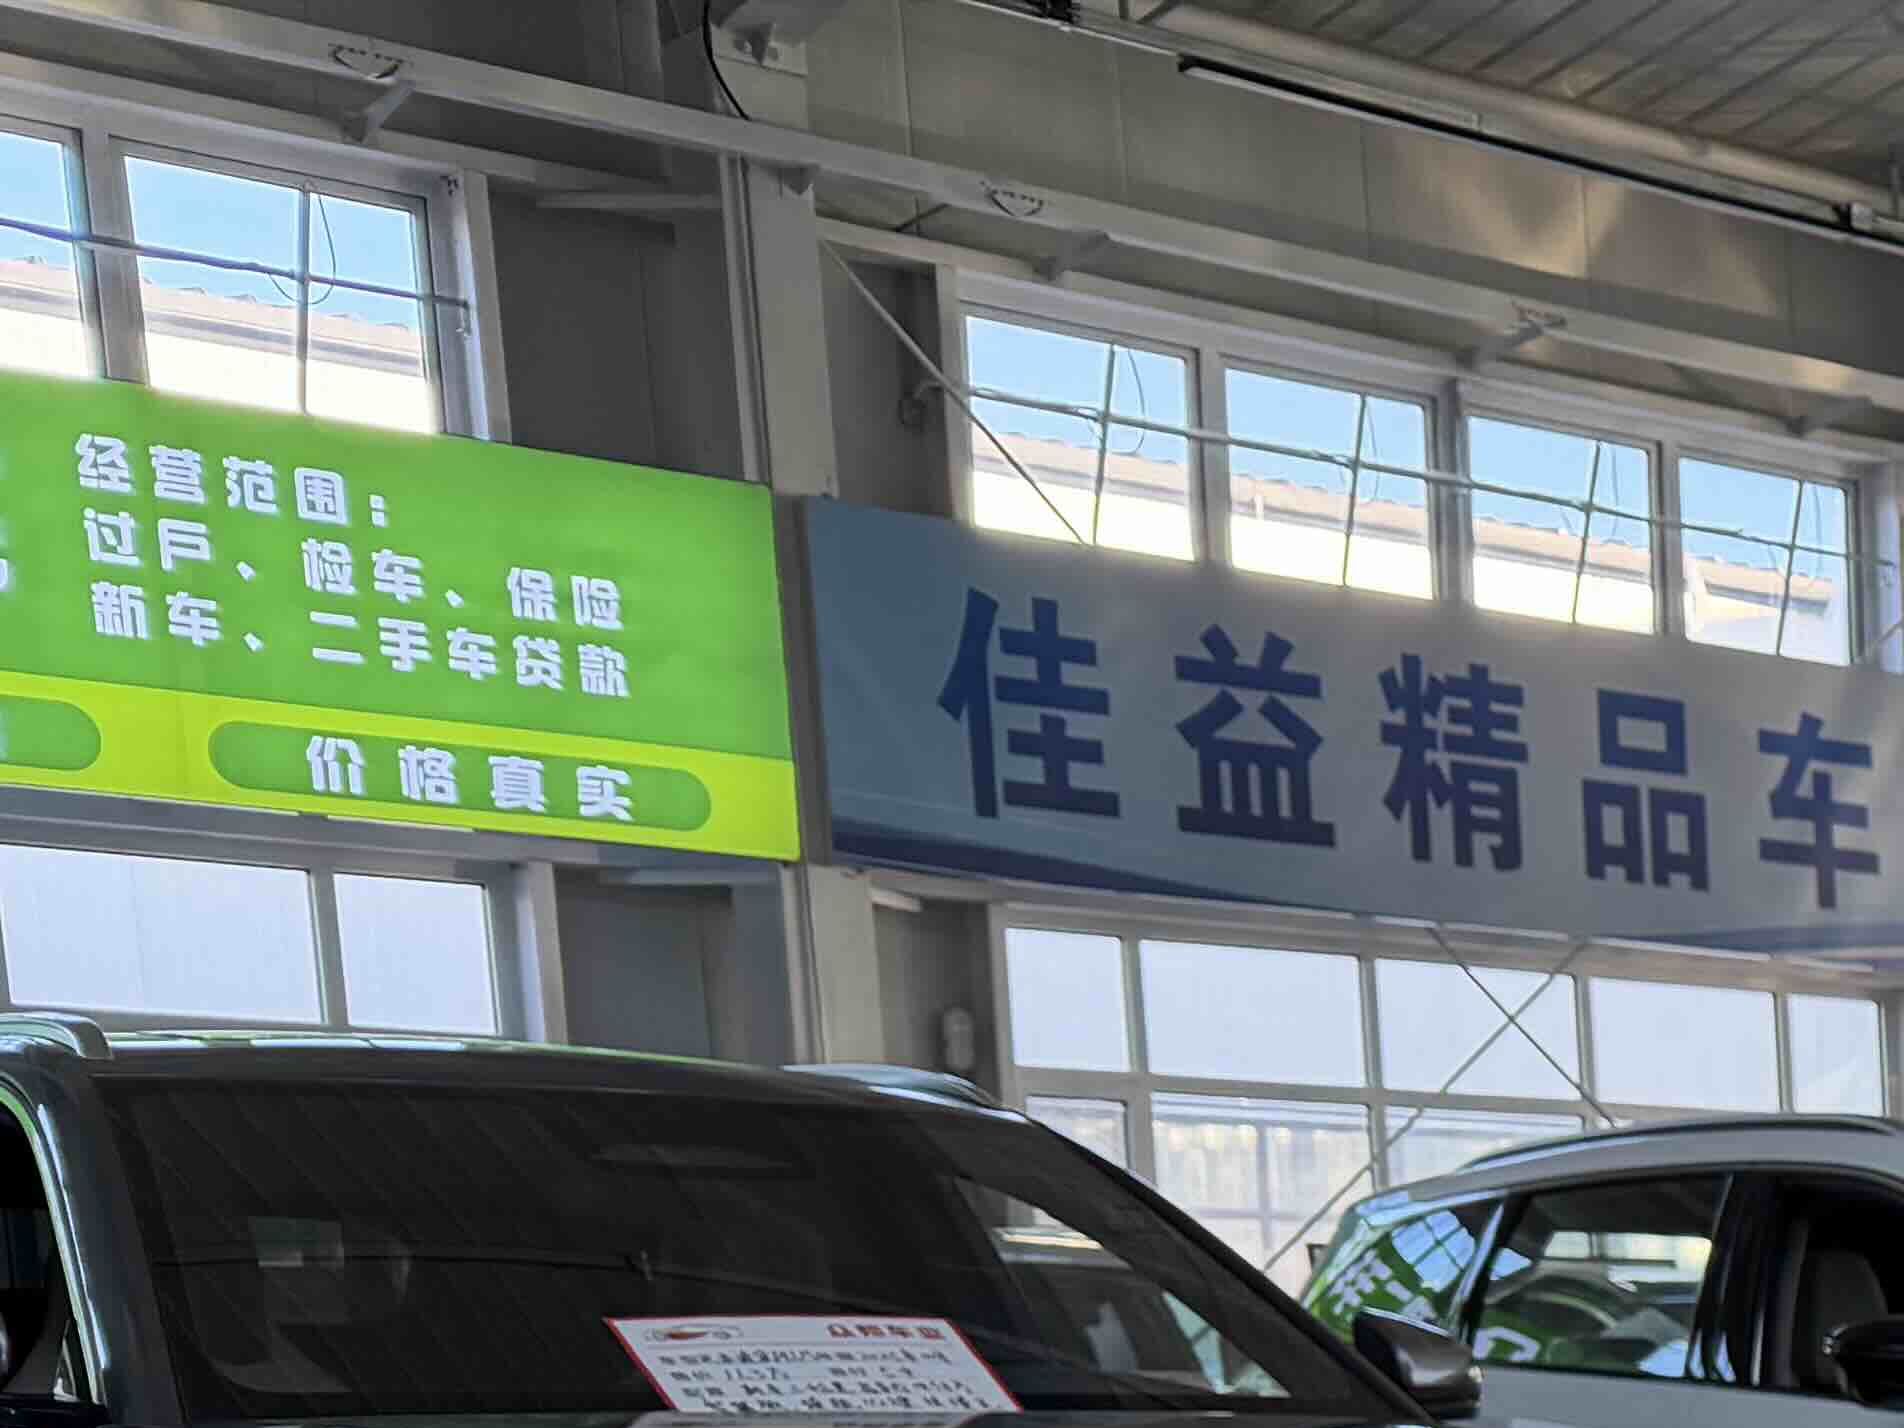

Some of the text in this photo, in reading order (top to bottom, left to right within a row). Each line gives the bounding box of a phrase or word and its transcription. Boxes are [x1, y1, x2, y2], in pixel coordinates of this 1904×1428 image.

[91, 580, 631, 699] 新车、二手车贷款
[306, 735, 634, 822] 价格真实
